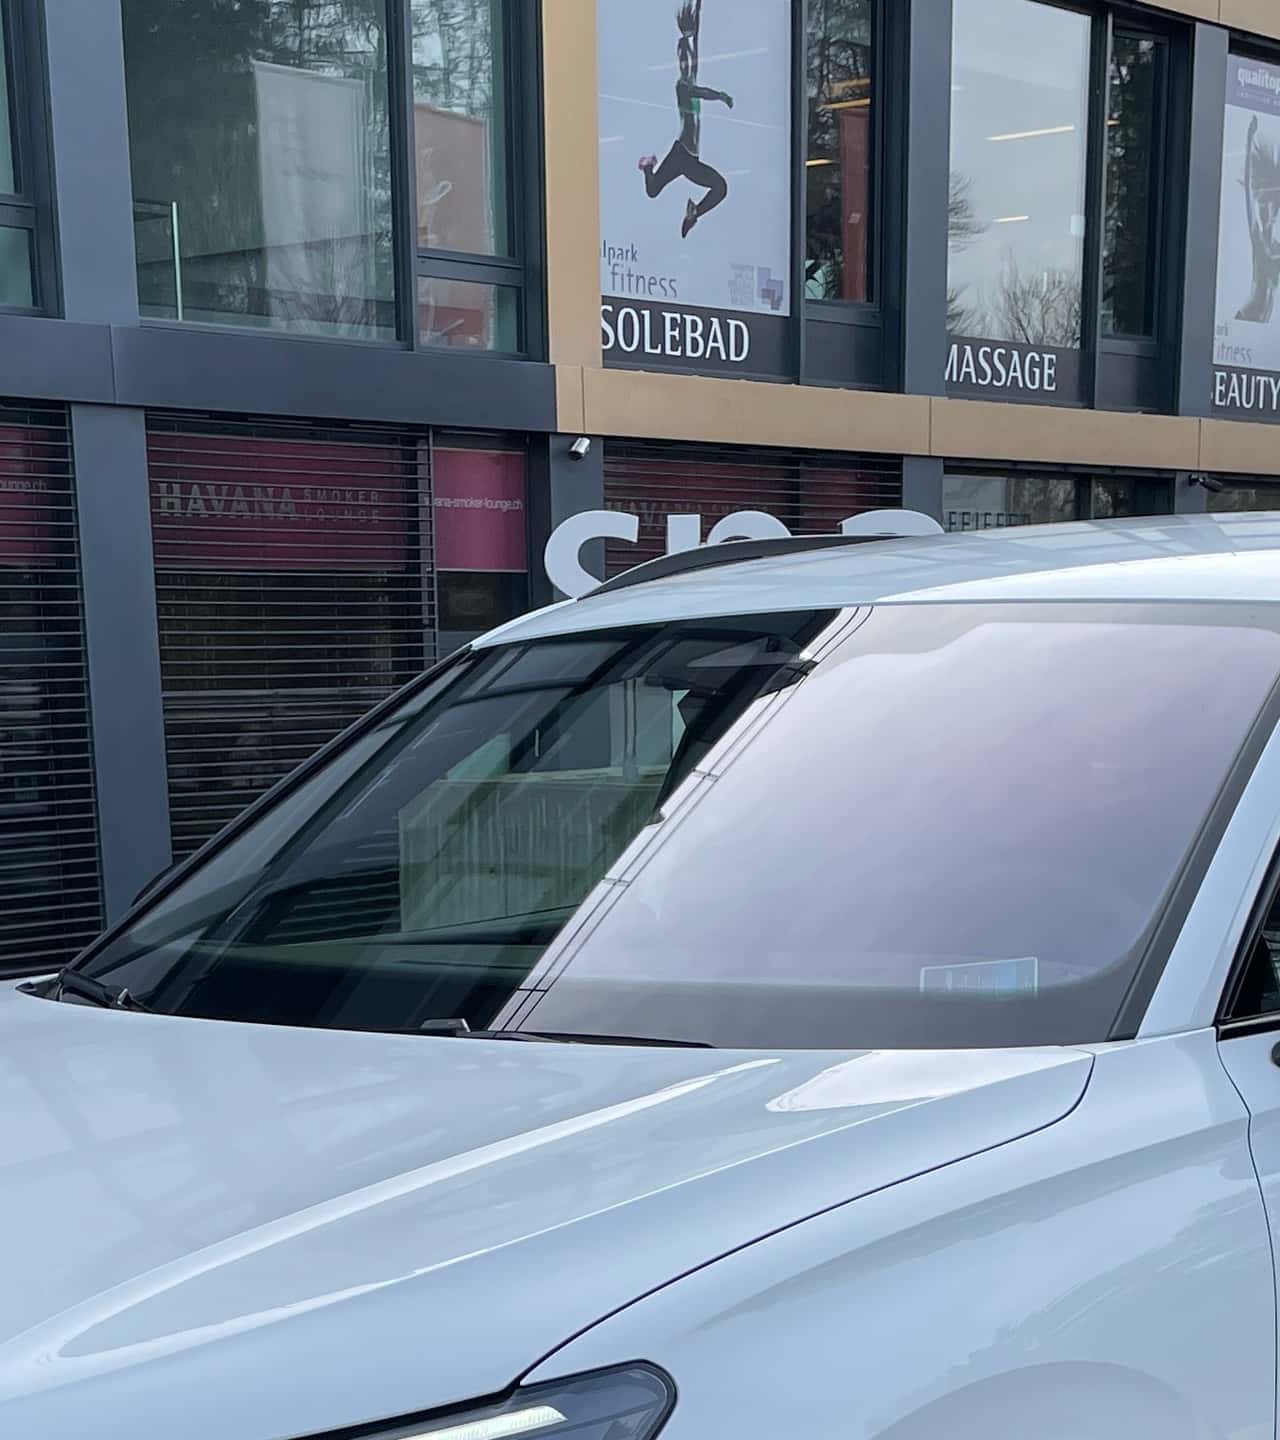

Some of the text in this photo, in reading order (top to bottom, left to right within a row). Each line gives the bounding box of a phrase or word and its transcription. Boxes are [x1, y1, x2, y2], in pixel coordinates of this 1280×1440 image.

[610, 263, 677, 298] fitness
[600, 304, 750, 362] SOLEBAD
[945, 343, 1058, 392] MASSAGE
[158, 482, 297, 520] HAVANA
